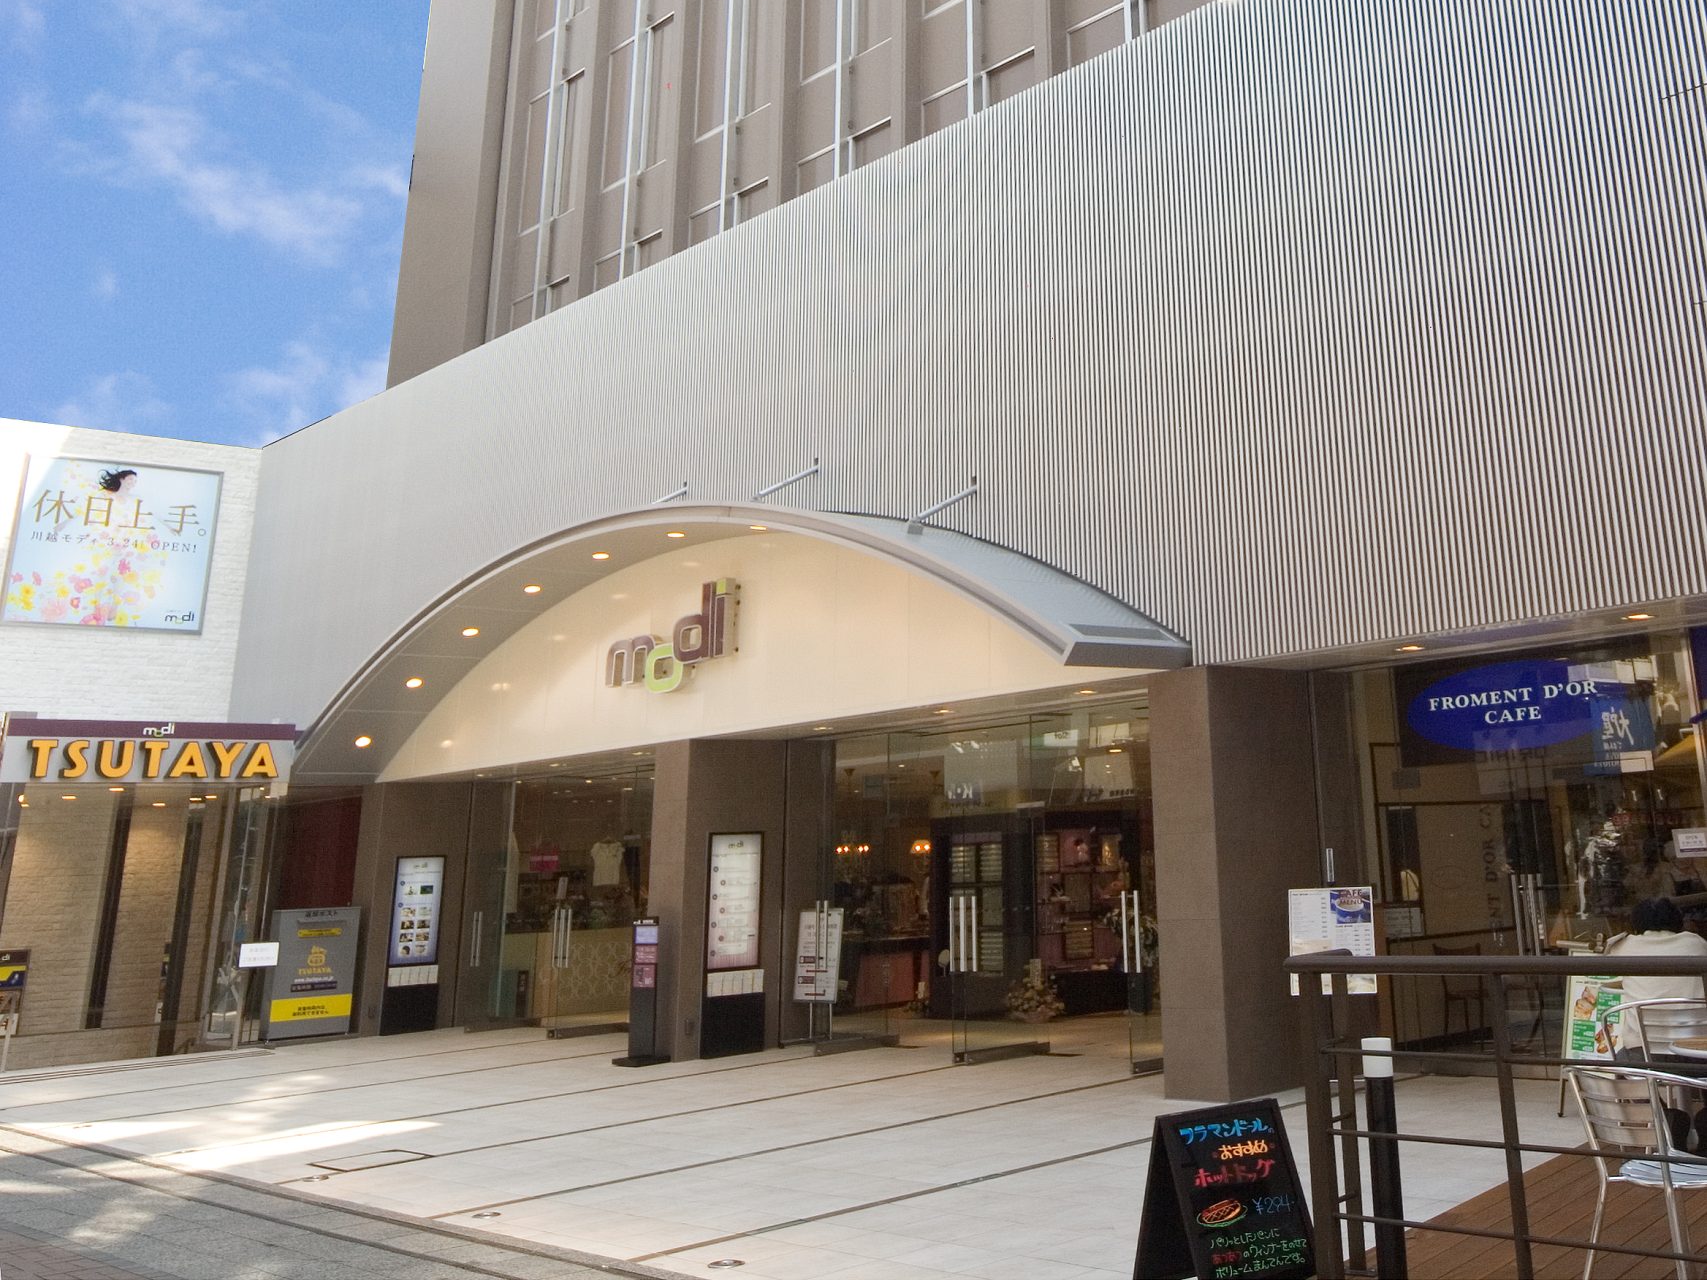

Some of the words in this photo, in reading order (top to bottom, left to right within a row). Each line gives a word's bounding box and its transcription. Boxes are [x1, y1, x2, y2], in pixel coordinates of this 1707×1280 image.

[32, 489, 207, 537] 休日上手。
[151, 540, 198, 554] OPEN!
[604, 577, 735, 694] modi
[1428, 686, 1533, 712] FROMENT
[1543, 679, 1598, 700] D'OR
[1484, 705, 1542, 725] CAFE
[143, 721, 175, 738] modi
[28, 739, 279, 780] TSUTAYA
[1218, 1139, 1269, 1161] おすすめ
